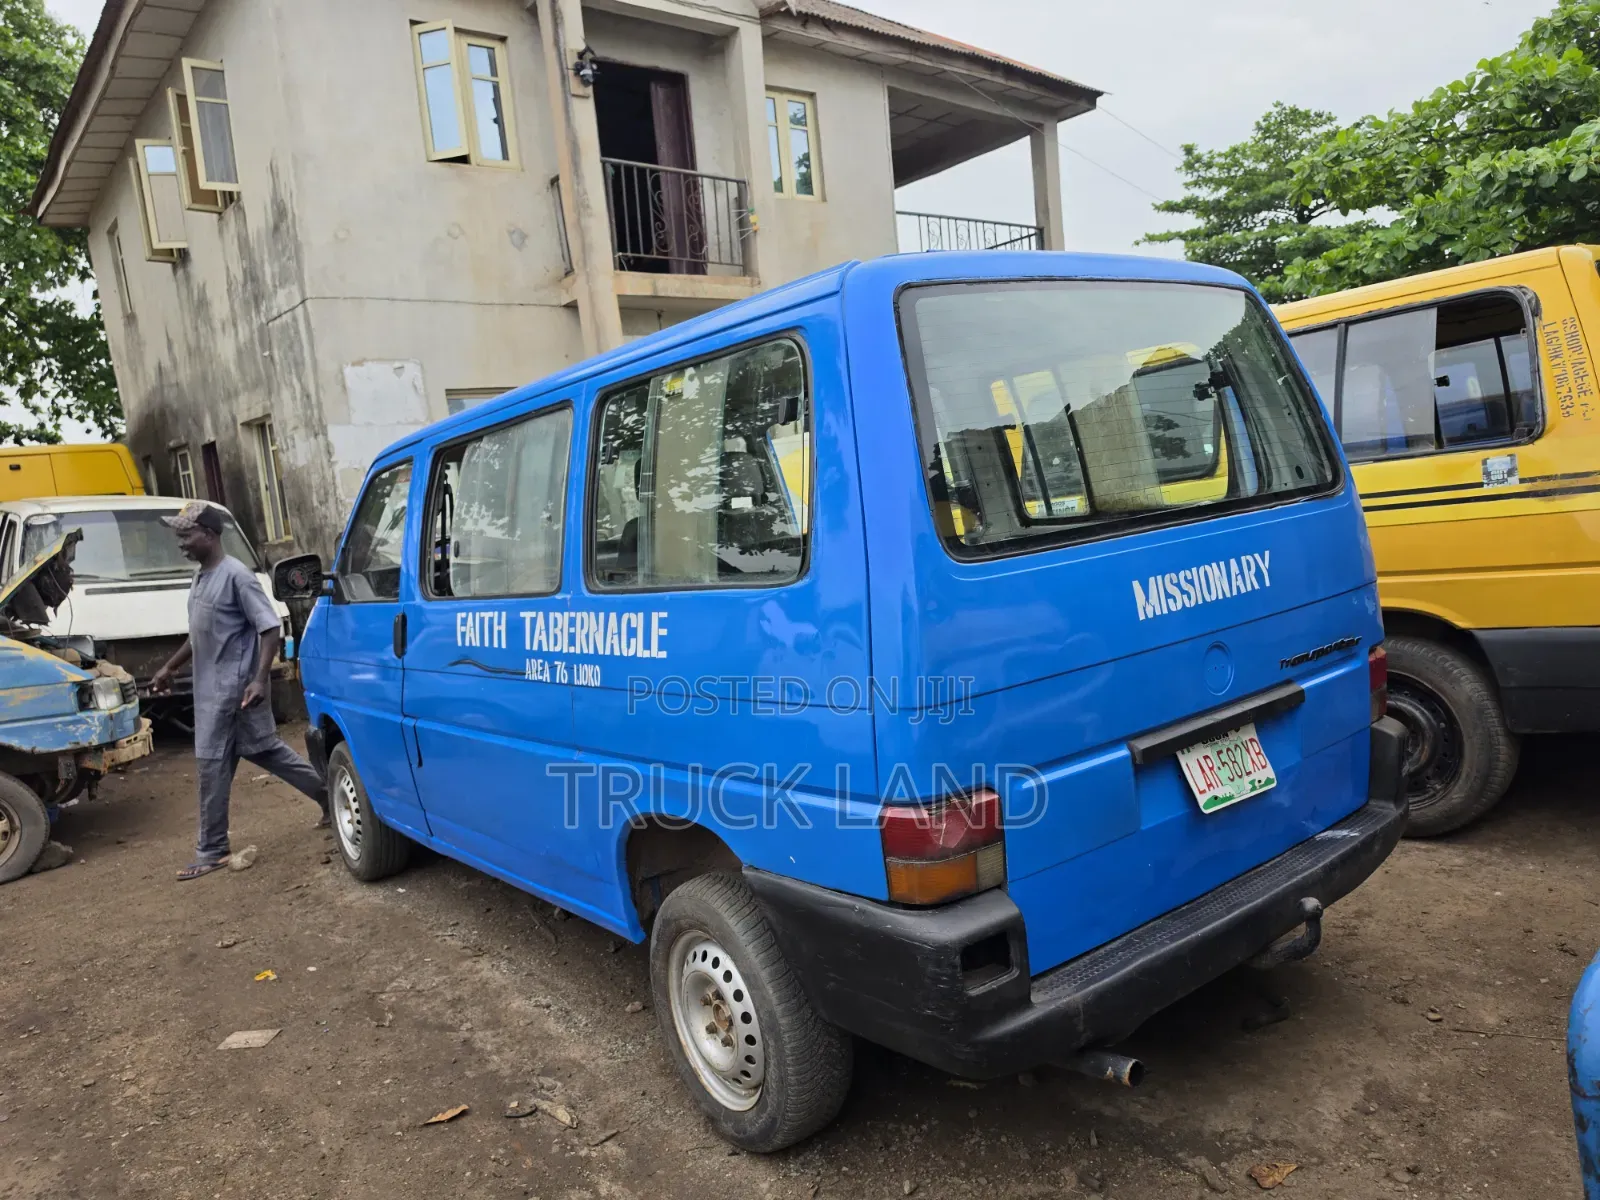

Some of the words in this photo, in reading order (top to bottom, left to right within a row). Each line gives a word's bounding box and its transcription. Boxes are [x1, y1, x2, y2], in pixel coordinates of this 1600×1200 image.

[1131, 550, 1271, 621] MISSIONARY
[456, 611, 507, 649] FAITH
[519, 611, 668, 659] TABERNACLE
[525, 658, 551, 683] AREA
[554, 660, 568, 684] 76
